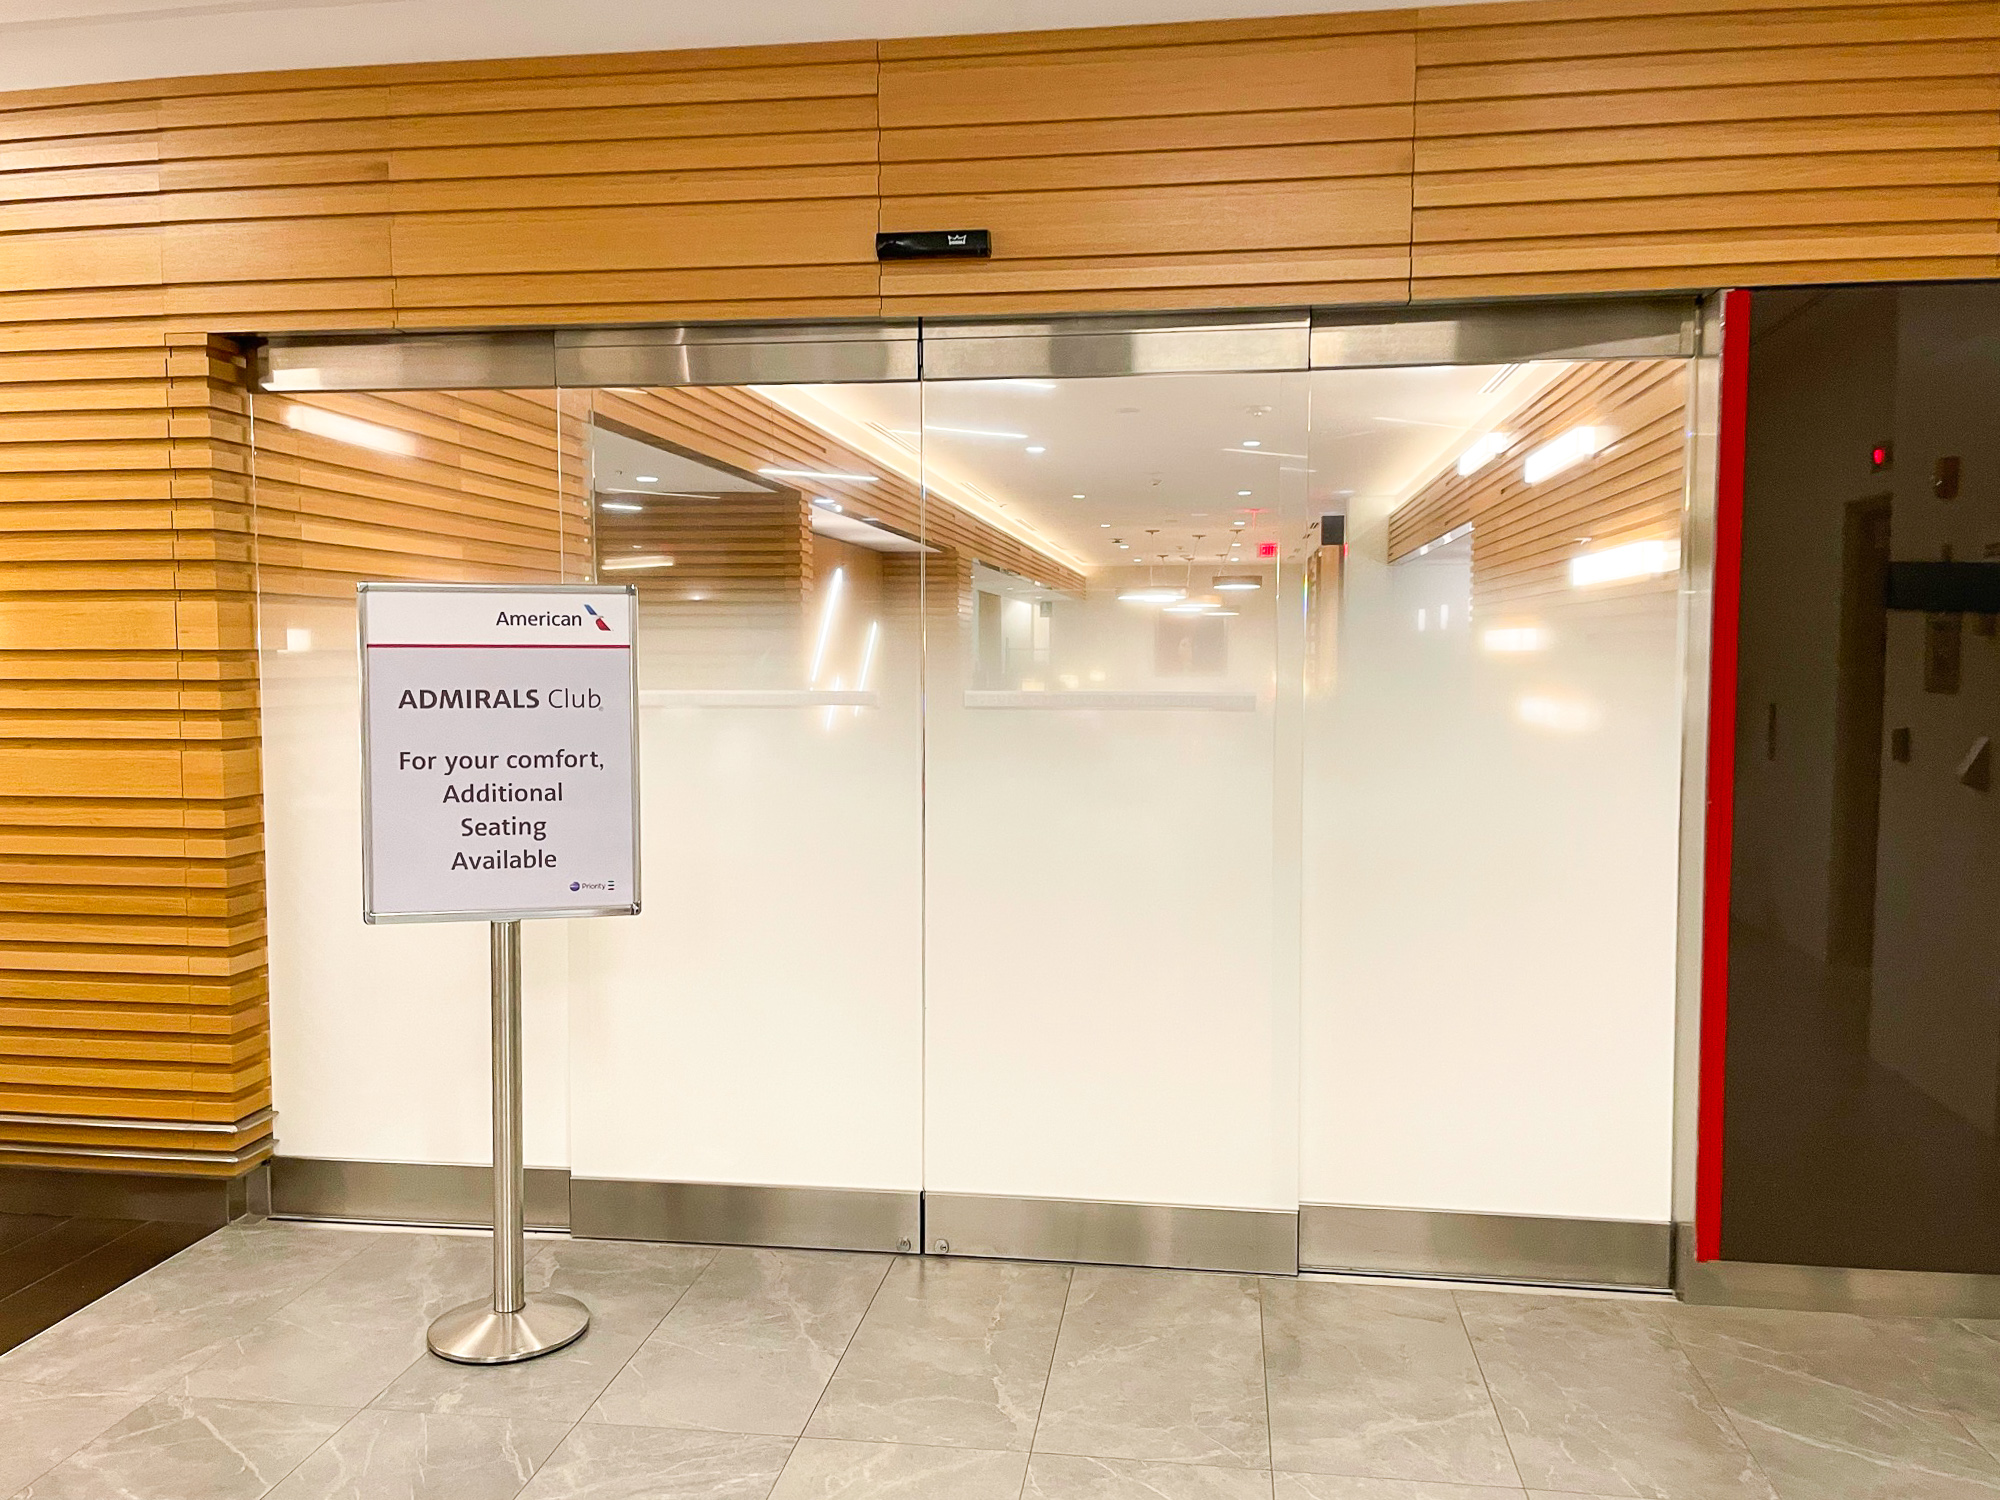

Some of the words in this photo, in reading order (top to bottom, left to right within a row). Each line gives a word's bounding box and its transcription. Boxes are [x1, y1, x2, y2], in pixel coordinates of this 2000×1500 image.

[496, 611, 583, 627] American
[398, 689, 540, 709] ADMIRALS
[548, 688, 602, 709] Club
[400, 752, 437, 770] For
[444, 755, 499, 775] your
[506, 749, 604, 771] comfort,
[442, 783, 563, 804] Additional
[461, 816, 547, 841] Seating
[451, 850, 557, 870] Available
[581, 882, 606, 890] Priority
